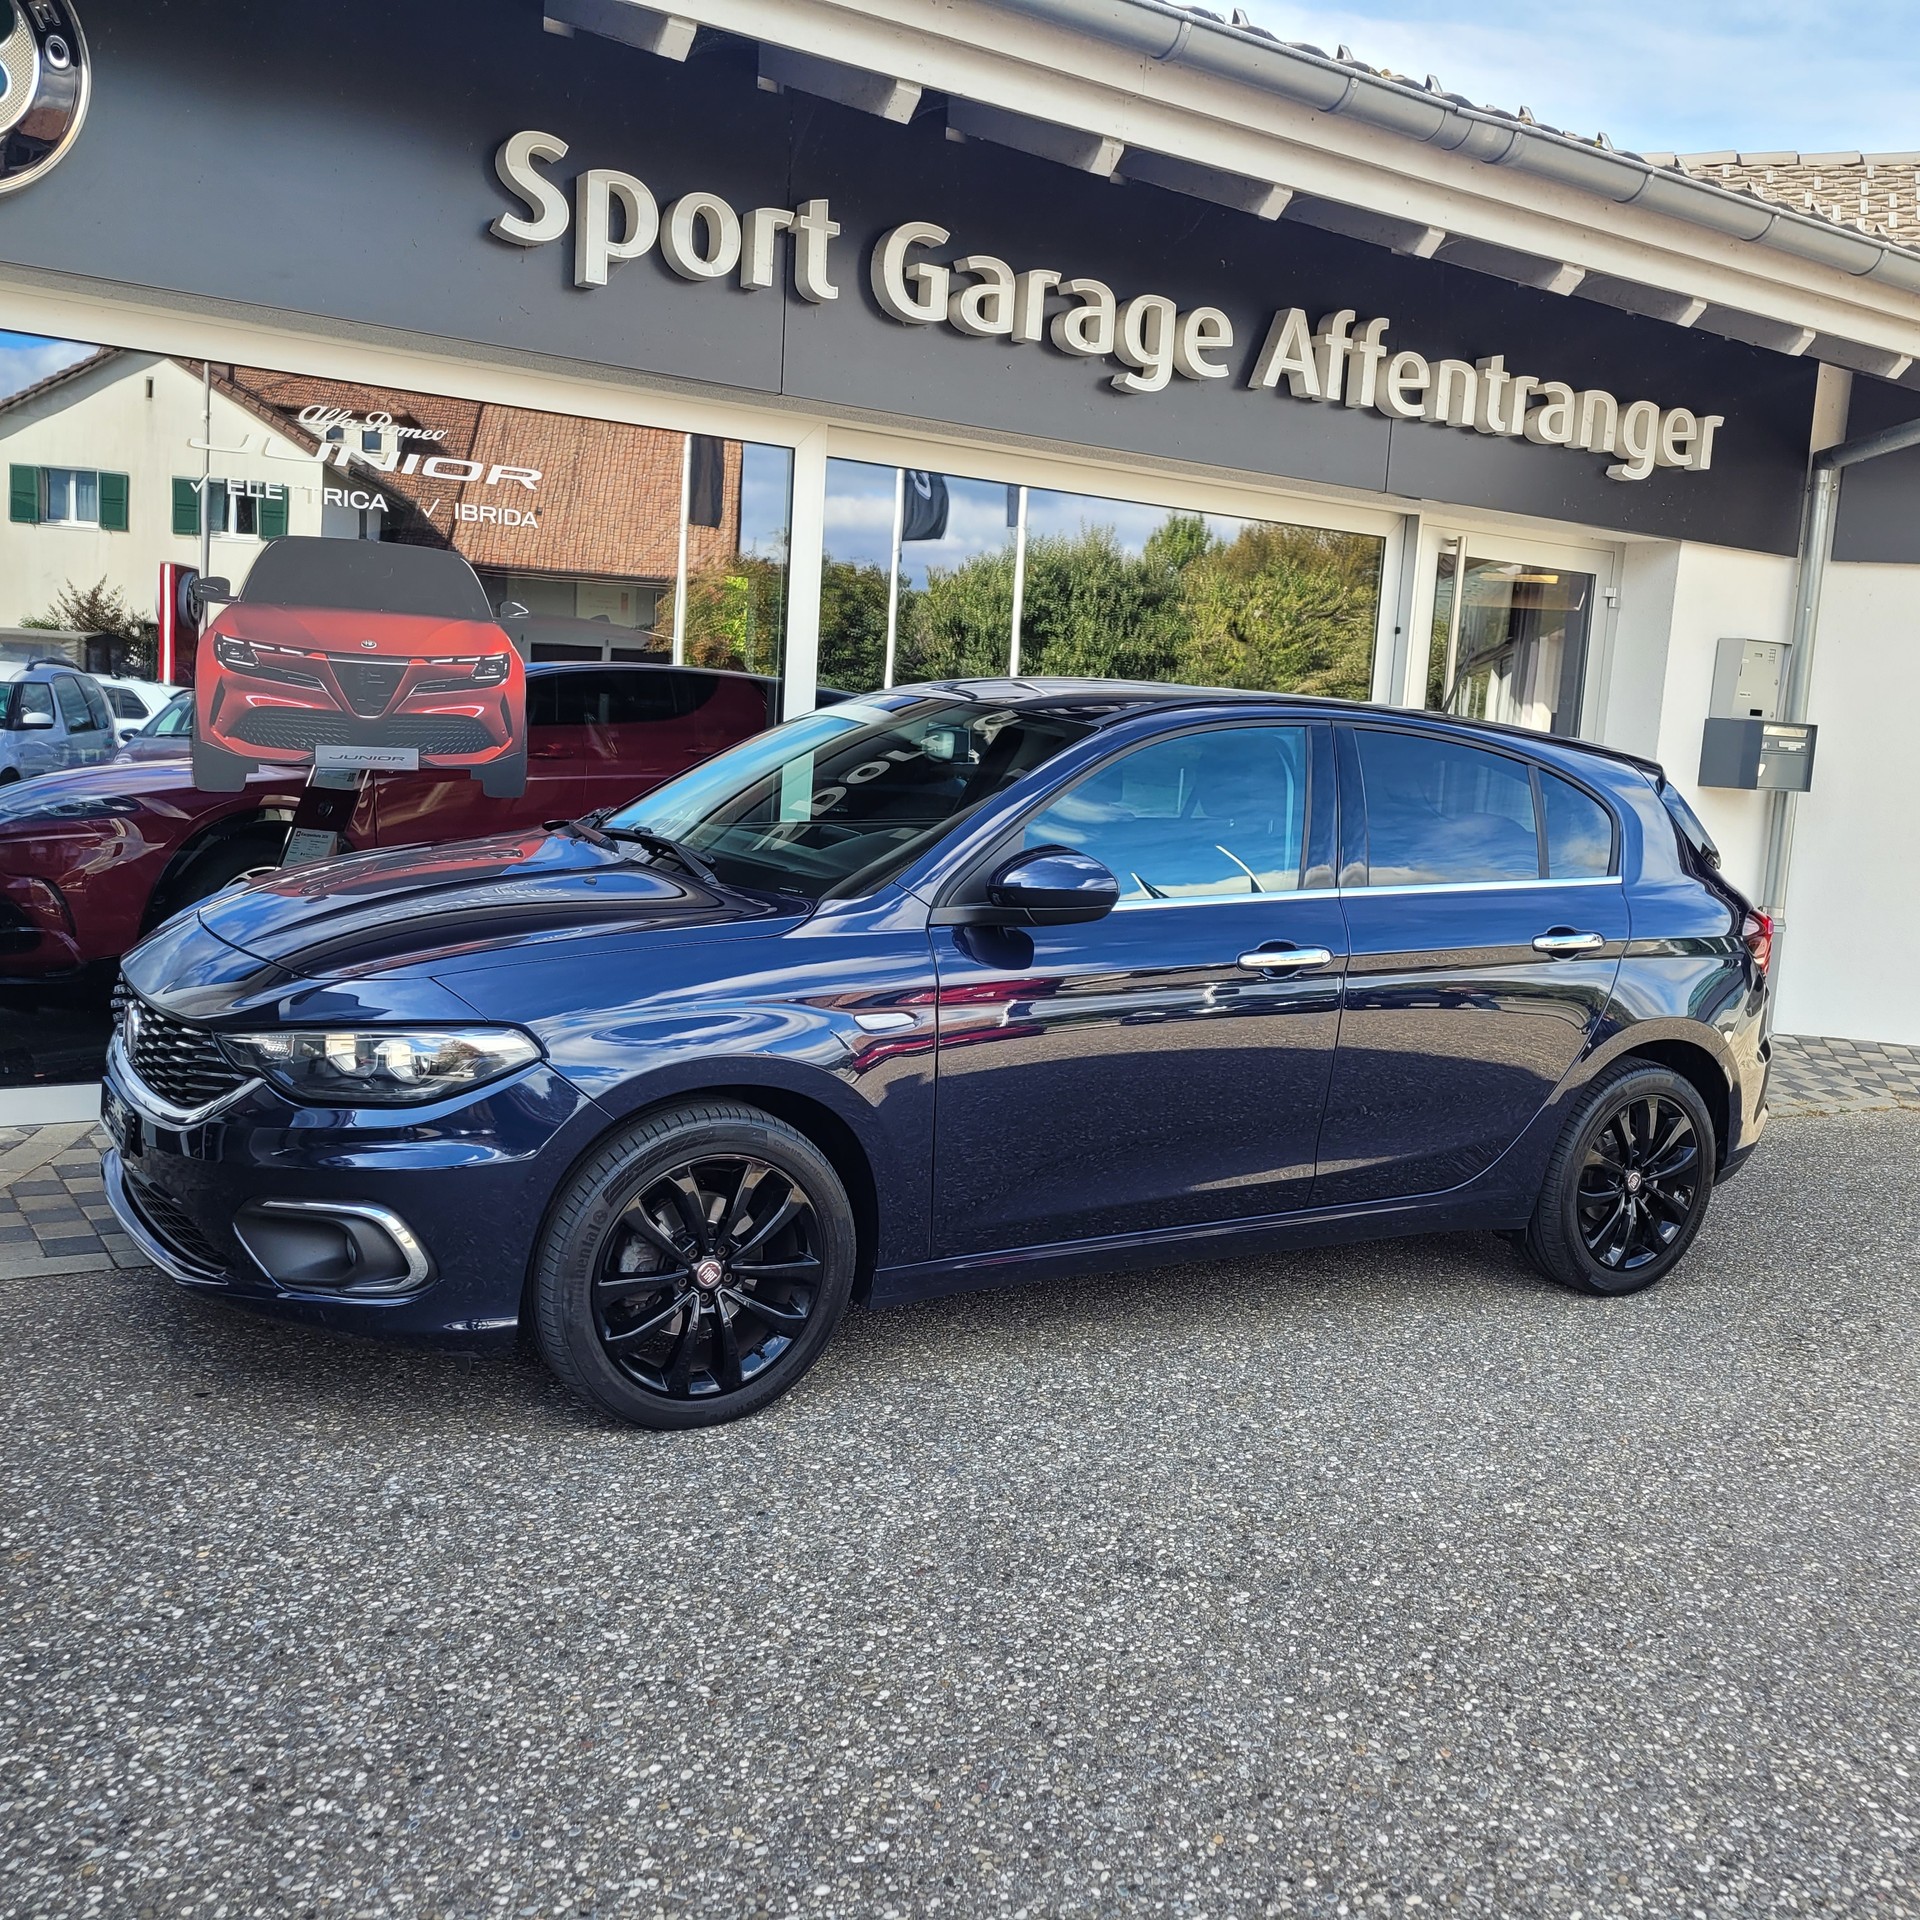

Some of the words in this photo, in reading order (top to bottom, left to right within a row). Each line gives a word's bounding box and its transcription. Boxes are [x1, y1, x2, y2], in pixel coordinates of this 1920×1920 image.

[490, 130, 840, 303] Sport
[869, 221, 1234, 394] Garage
[1247, 307, 1725, 481] Affentranger
[298, 404, 358, 433] Alfa
[362, 411, 448, 441] Romeo
[187, 433, 543, 491] JUNIOR
[454, 502, 540, 529] IBRIDA
[328, 754, 406, 762] JUNIOR
